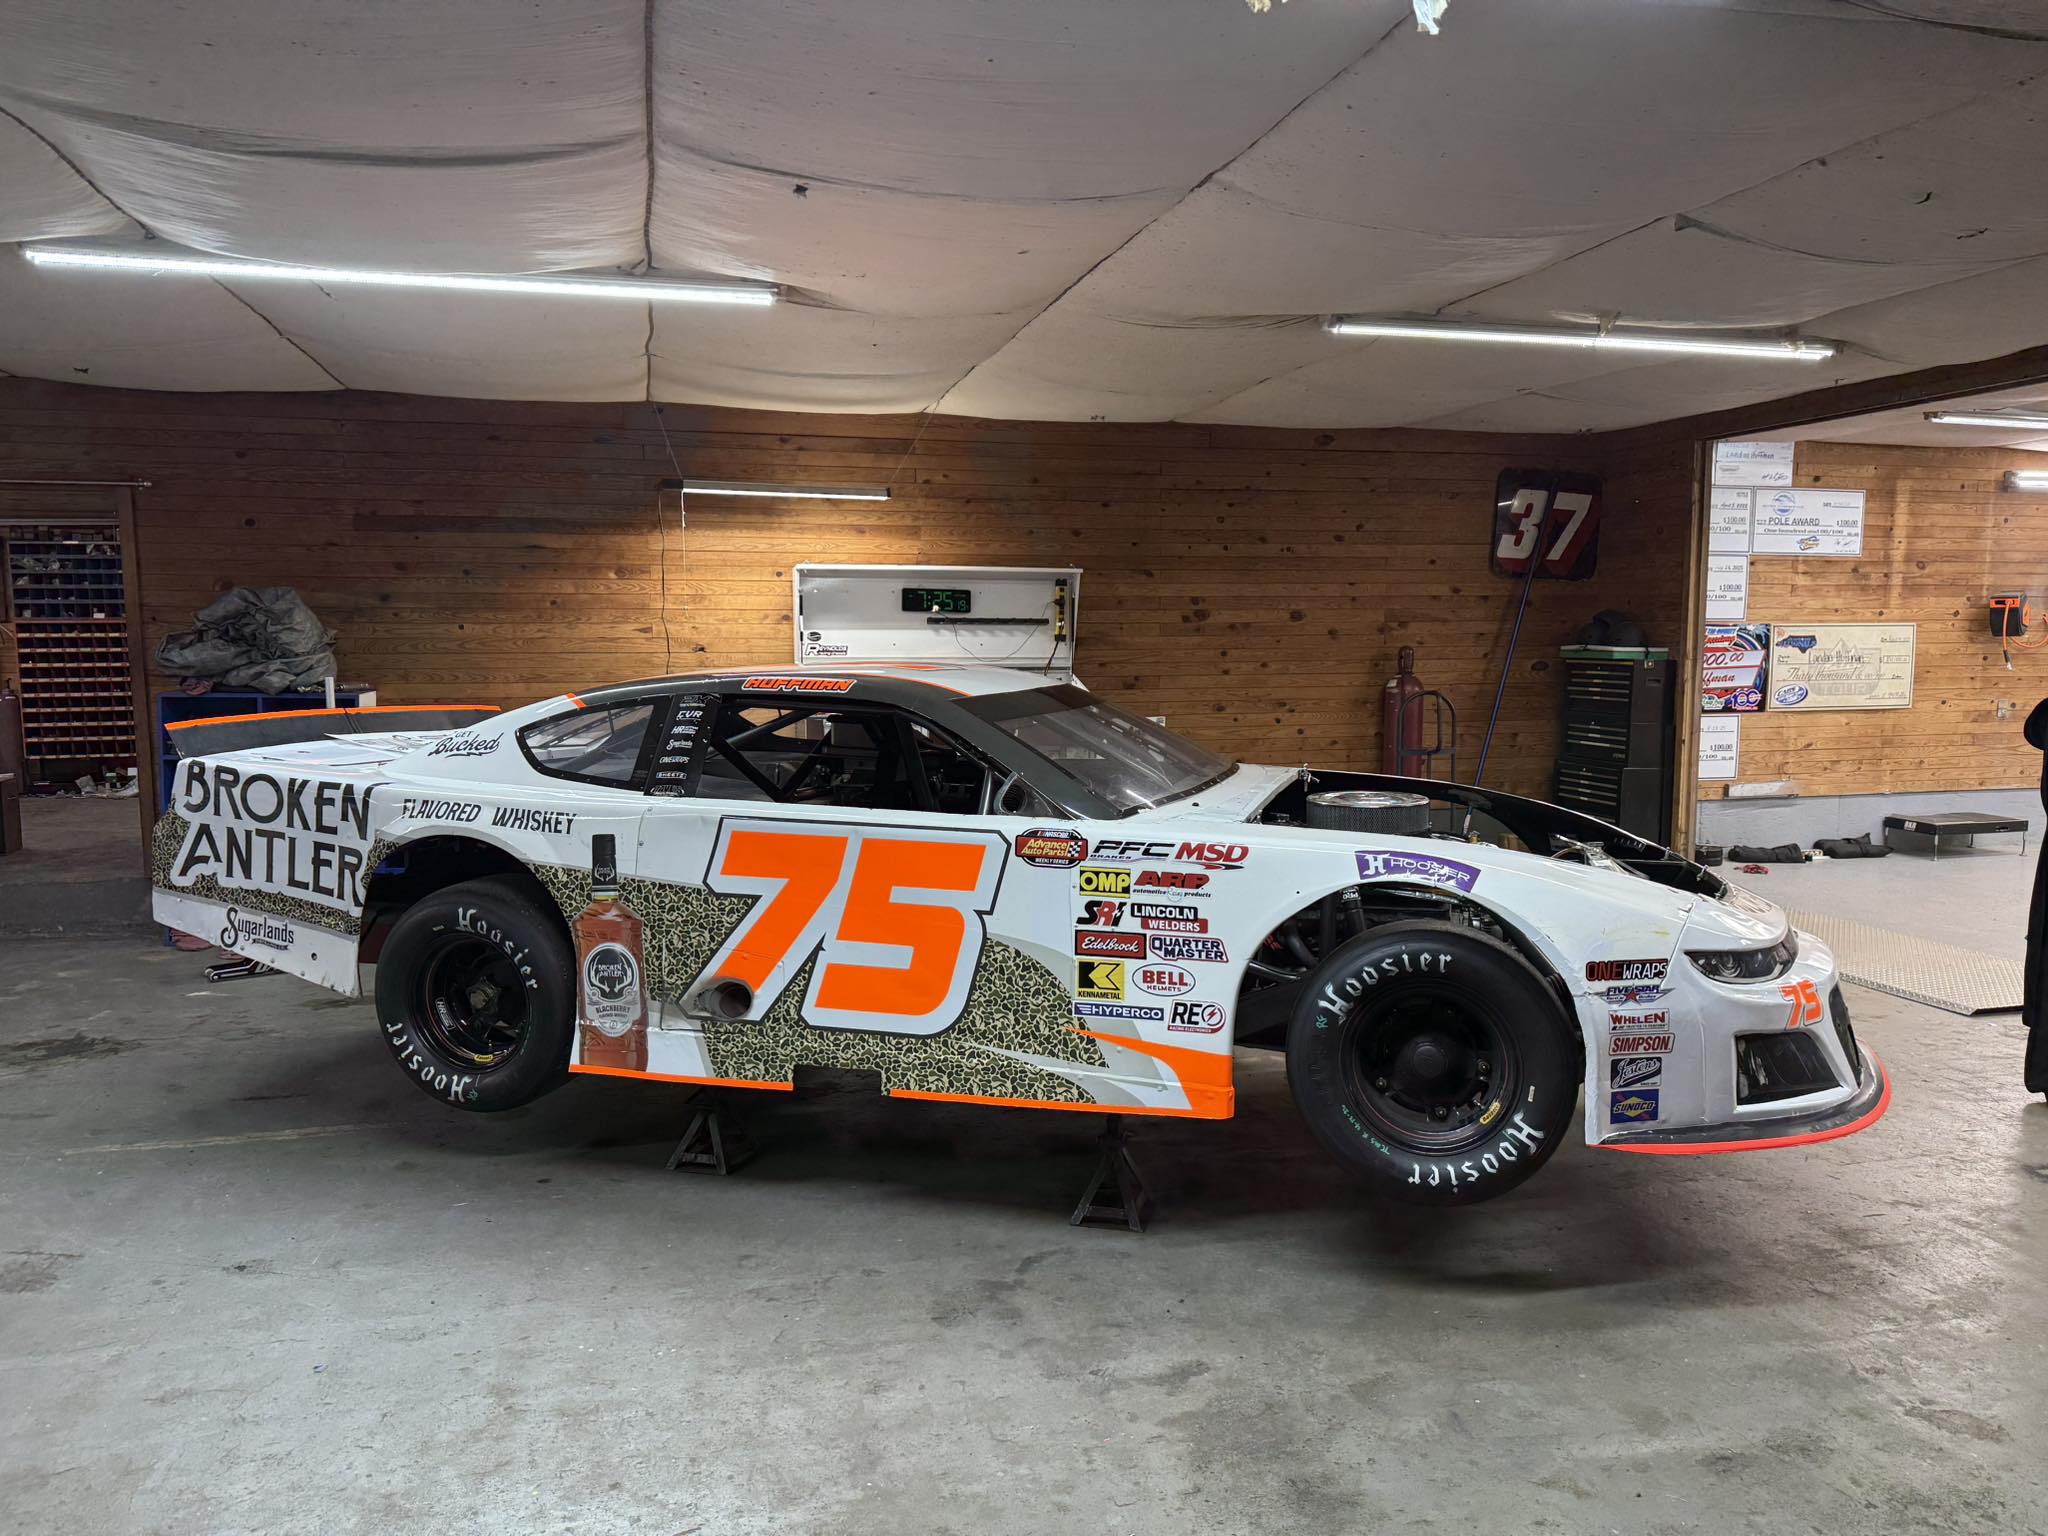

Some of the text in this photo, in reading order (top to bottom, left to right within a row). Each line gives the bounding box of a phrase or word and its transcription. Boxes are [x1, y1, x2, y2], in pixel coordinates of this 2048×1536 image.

[1496, 488, 1593, 562] 37
[1768, 516, 1790, 525] POLE
[1791, 517, 1820, 527] AWARD
[743, 678, 856, 692] HUFFMAN
[428, 731, 504, 757] Bucked
[183, 759, 376, 842] BROKEN
[402, 798, 577, 835] FLAVORED WHISKEY
[1021, 846, 1066, 857] Auto Parts
[1024, 839, 1068, 850] Advance
[1092, 840, 1176, 857] PFC
[1175, 842, 1250, 863] MSD
[177, 823, 364, 908] ANTLER
[1080, 871, 1131, 893] OMP
[1133, 870, 1210, 890] ARP
[1133, 904, 1195, 920] LINCOLN
[220, 906, 295, 949] Sugarlands
[706, 829, 988, 1018] 75
[1148, 918, 1201, 933] WELDERS
[455, 906, 538, 989] Hoosier
[1081, 936, 1140, 953] Edelbrock
[1151, 937, 1221, 951] QUARTER
[1163, 949, 1225, 961] MASTER
[598, 963, 623, 971] BROKEN
[1142, 969, 1188, 987] BELL
[1077, 990, 1122, 1000] KENNAMETAL
[1317, 951, 1453, 1024] Hoosier
[1606, 984, 1660, 996] FIVE STAR
[595, 1004, 631, 1014] BLACKBERRY
[1091, 1006, 1163, 1020] HYPERCO
[1778, 978, 1824, 1030] 75
[1610, 1011, 1667, 1025] WHELEN
[1611, 1035, 1671, 1053] SIMPSON
[386, 1021, 473, 1103] Hoosier
[1612, 1058, 1661, 1089] Jostens
[1614, 1100, 1656, 1114] SUNOCO
[1407, 1111, 1545, 1193] Hoosier
